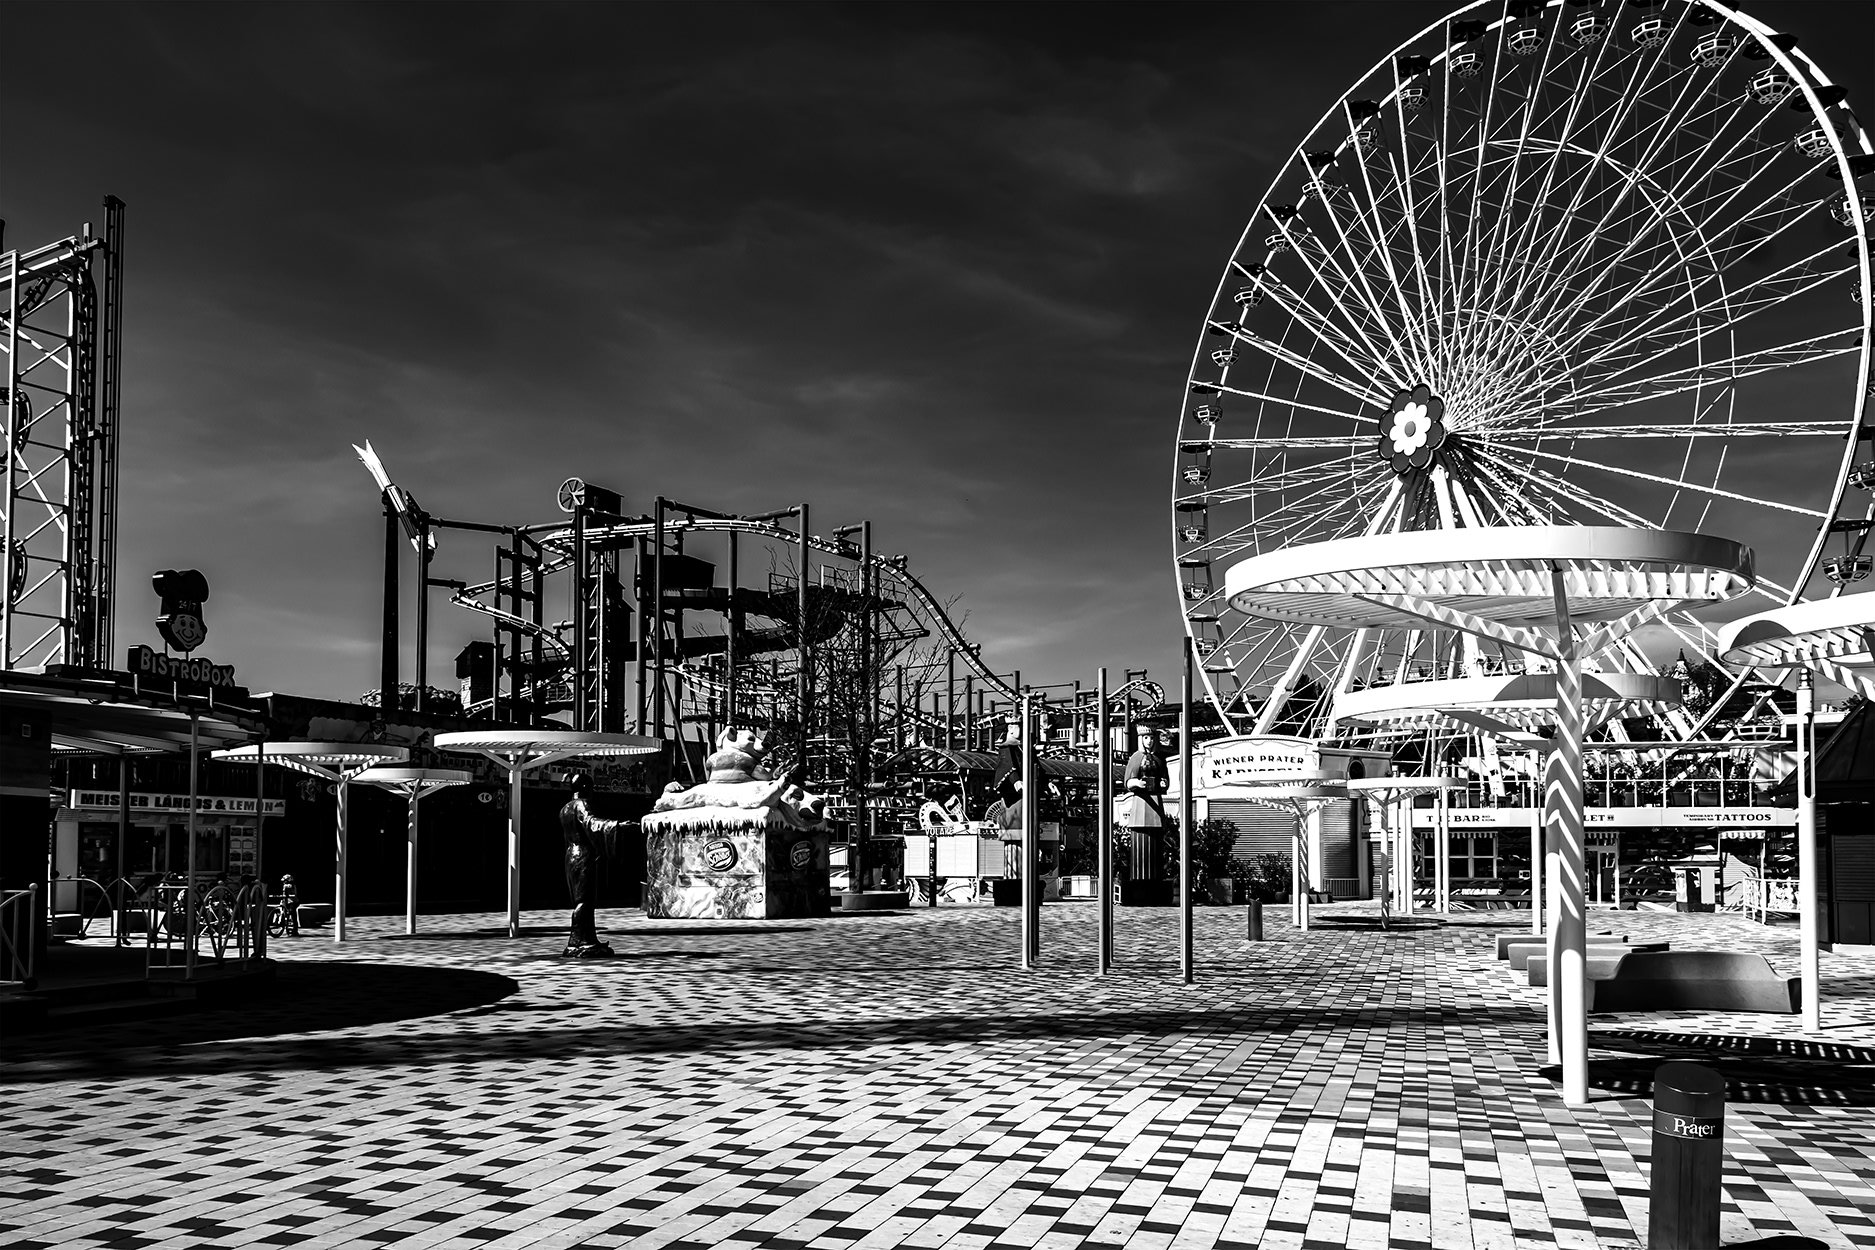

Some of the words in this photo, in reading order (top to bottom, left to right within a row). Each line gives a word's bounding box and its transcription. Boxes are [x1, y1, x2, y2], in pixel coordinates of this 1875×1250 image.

[178, 600, 197, 611] 24/7
[1213, 755, 1254, 766] WIENER
[1259, 755, 1304, 764] PRATER
[80, 793, 149, 807] MEISER
[215, 799, 226, 810] &
[1673, 1117, 1716, 1137] Prater
